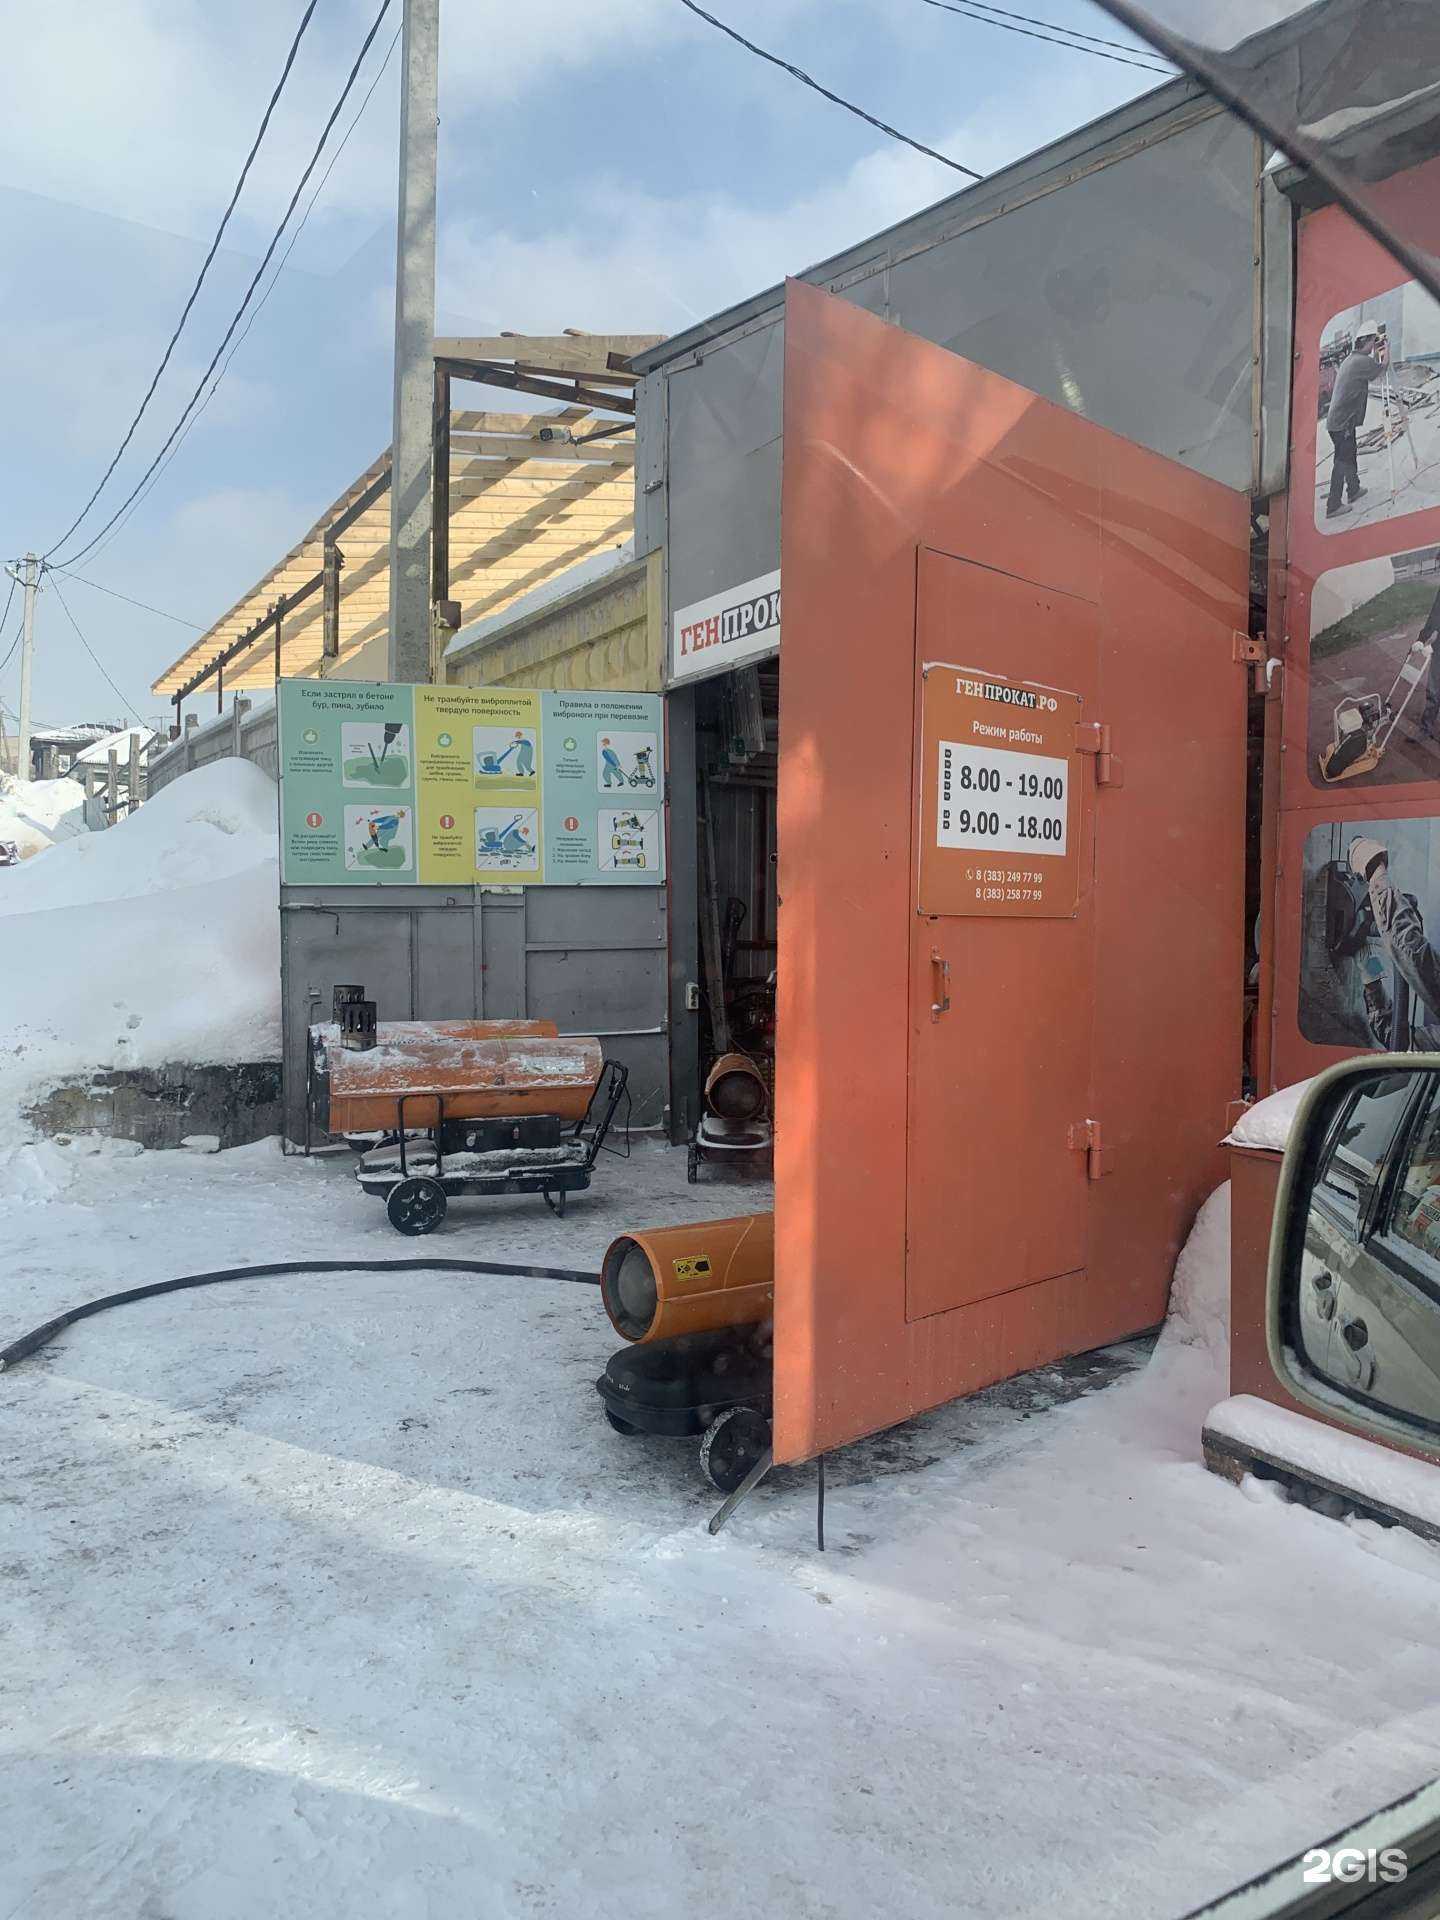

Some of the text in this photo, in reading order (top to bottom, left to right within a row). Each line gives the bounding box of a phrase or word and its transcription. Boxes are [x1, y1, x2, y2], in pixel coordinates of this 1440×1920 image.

[301, 689, 321, 698] Если
[365, 691, 395, 700] бетоне
[423, 694, 532, 707] Не трамбуйте виброплитой
[955, 678, 1058, 712] ГЕНПРОКАТ.РФ
[356, 702, 385, 711] зубило
[436, 706, 521, 717] твердую поверхность
[559, 700, 592, 710] Правила
[600, 702, 643, 711] положении
[552, 710, 649, 721] виброноги при перевозке
[972, 720, 1043, 744] Режим работы
[960, 765, 1000, 792] 8.00
[1018, 773, 1063, 800] 19.00
[959, 809, 1000, 835] 9.00
[1017, 815, 1062, 841] 18.00
[976, 869, 1043, 884] 8 (383) 249 77 99
[975, 887, 1042, 901] 8 (383) 258 77 99
